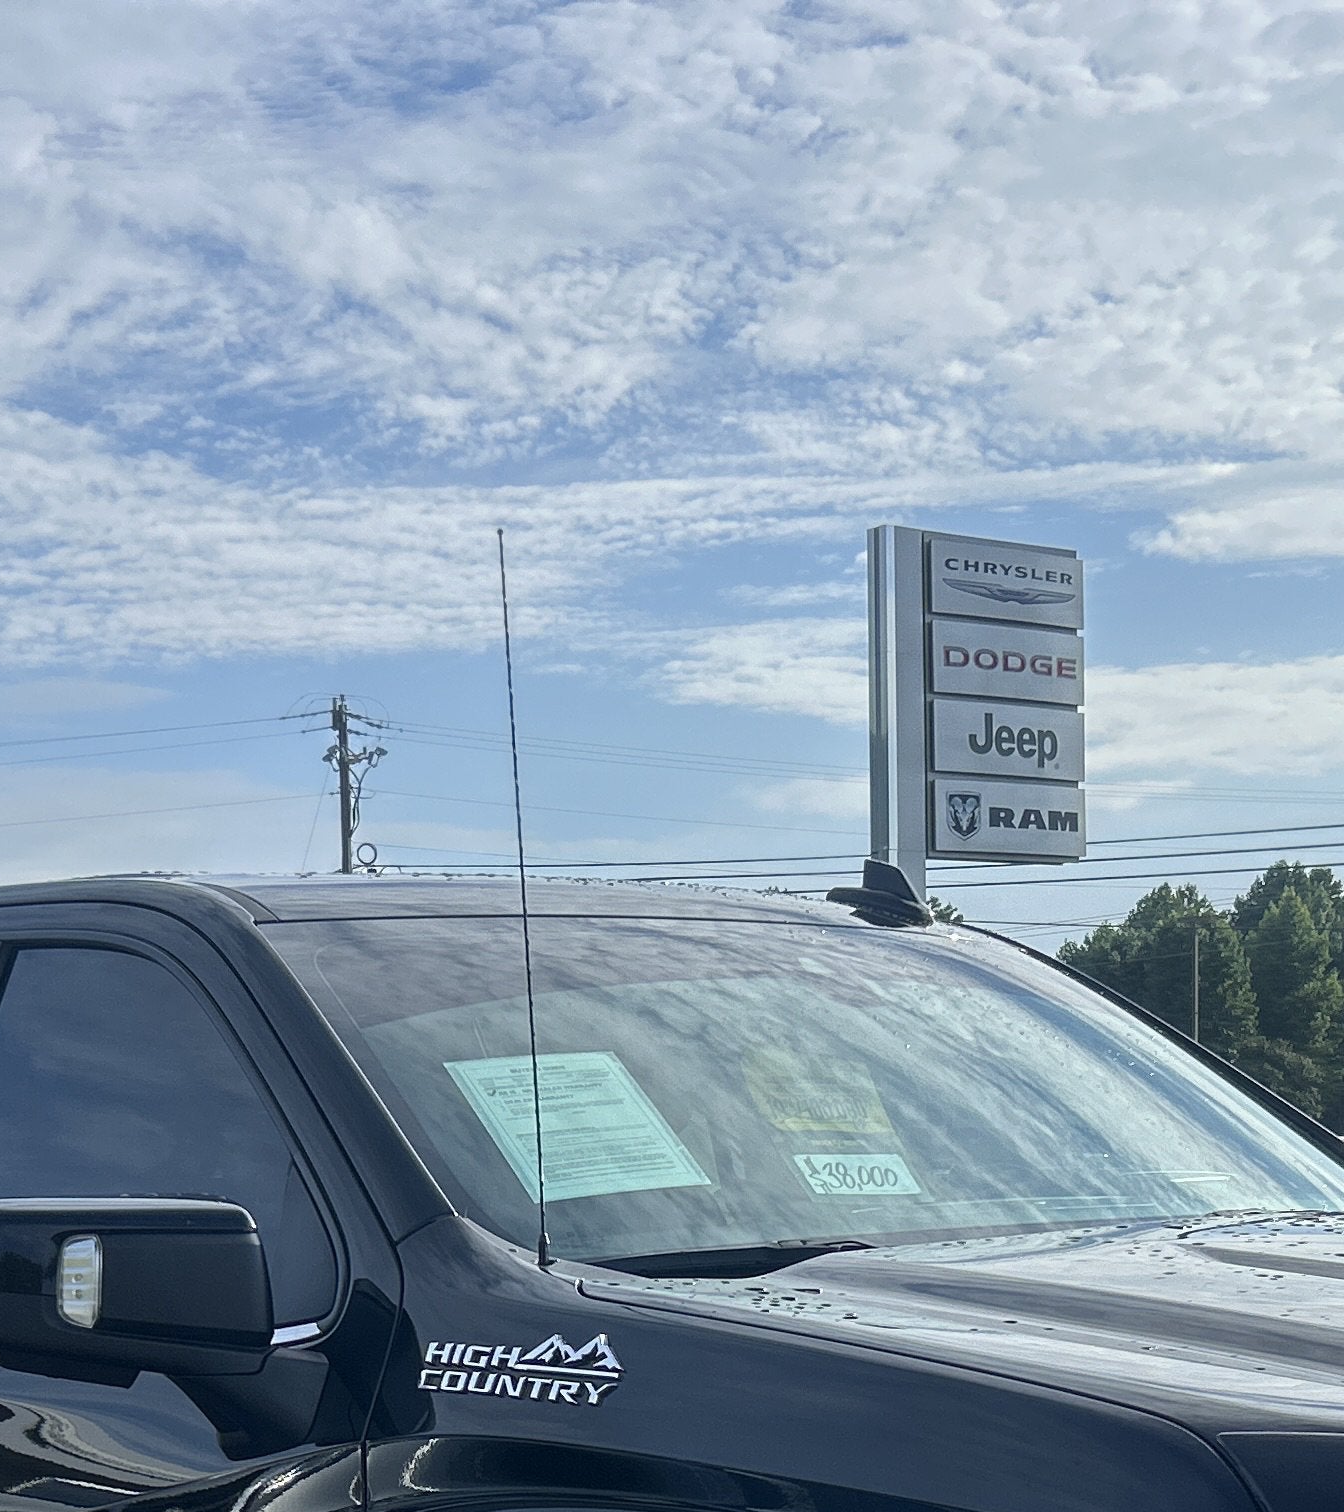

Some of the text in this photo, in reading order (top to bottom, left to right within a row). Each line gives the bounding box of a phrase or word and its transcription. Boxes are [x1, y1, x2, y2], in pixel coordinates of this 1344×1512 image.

[944, 558, 1073, 586] CHRYSLER
[943, 645, 1077, 680] DODGE
[968, 712, 1058, 769] Jeep
[988, 806, 1079, 833] RAM
[803, 1155, 898, 1194] $38,000
[424, 1341, 523, 1369] HIGH
[418, 1368, 618, 1405] COUNTRY
